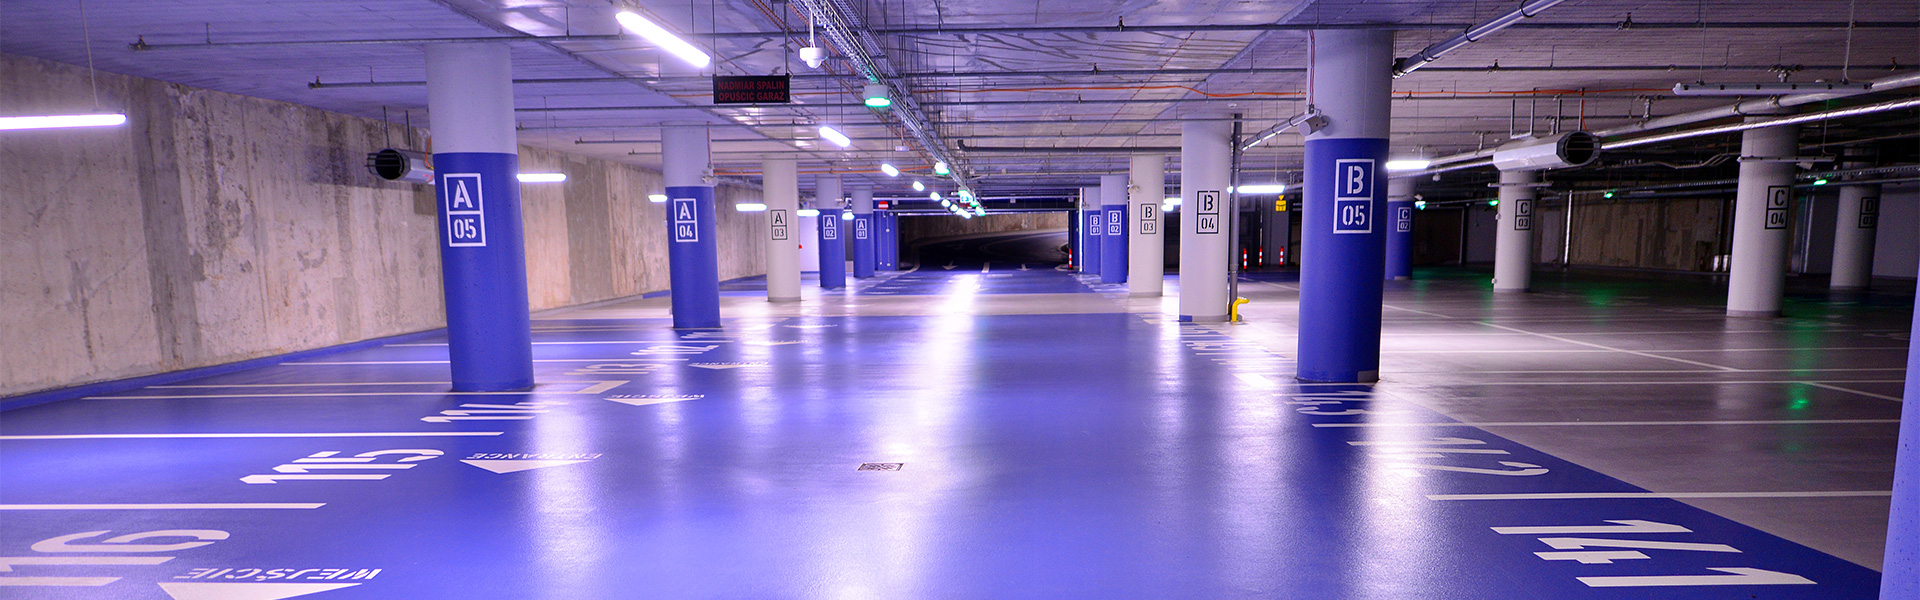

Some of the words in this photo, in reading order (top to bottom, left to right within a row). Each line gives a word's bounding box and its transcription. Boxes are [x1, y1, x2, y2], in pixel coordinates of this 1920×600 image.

[718, 81, 755, 90] NADMIAR
[756, 81, 785, 90] SPALIN
[718, 91, 755, 101] OPUŚCIĆ
[756, 90, 785, 101] GARAŻ
[1346, 165, 1364, 194] B
[453, 180, 473, 208] A
[1774, 189, 1785, 206] C
[1203, 194, 1214, 211] B
[1520, 202, 1528, 214] C
[679, 202, 692, 220] A
[1111, 212, 1118, 222] B
[1145, 206, 1152, 218] B
[1342, 205, 1365, 226] 05
[1401, 209, 1408, 219] C
[774, 212, 783, 224] A
[825, 217, 833, 227] A
[1092, 216, 1098, 226] B
[1201, 217, 1214, 229] 04
[1518, 218, 1528, 227] 03
[1770, 212, 1784, 225] 04
[454, 218, 477, 239] 05
[858, 220, 865, 229] A
[1110, 225, 1119, 233] 02
[1143, 222, 1153, 231] 03
[679, 225, 693, 238] 04
[774, 228, 784, 237] 03
[420, 401, 570, 422] 114
[1346, 437, 1550, 477] 142
[239, 448, 445, 484] 115
[1489, 519, 1818, 588] 141
[173, 567, 382, 582] WEJŚCIE
